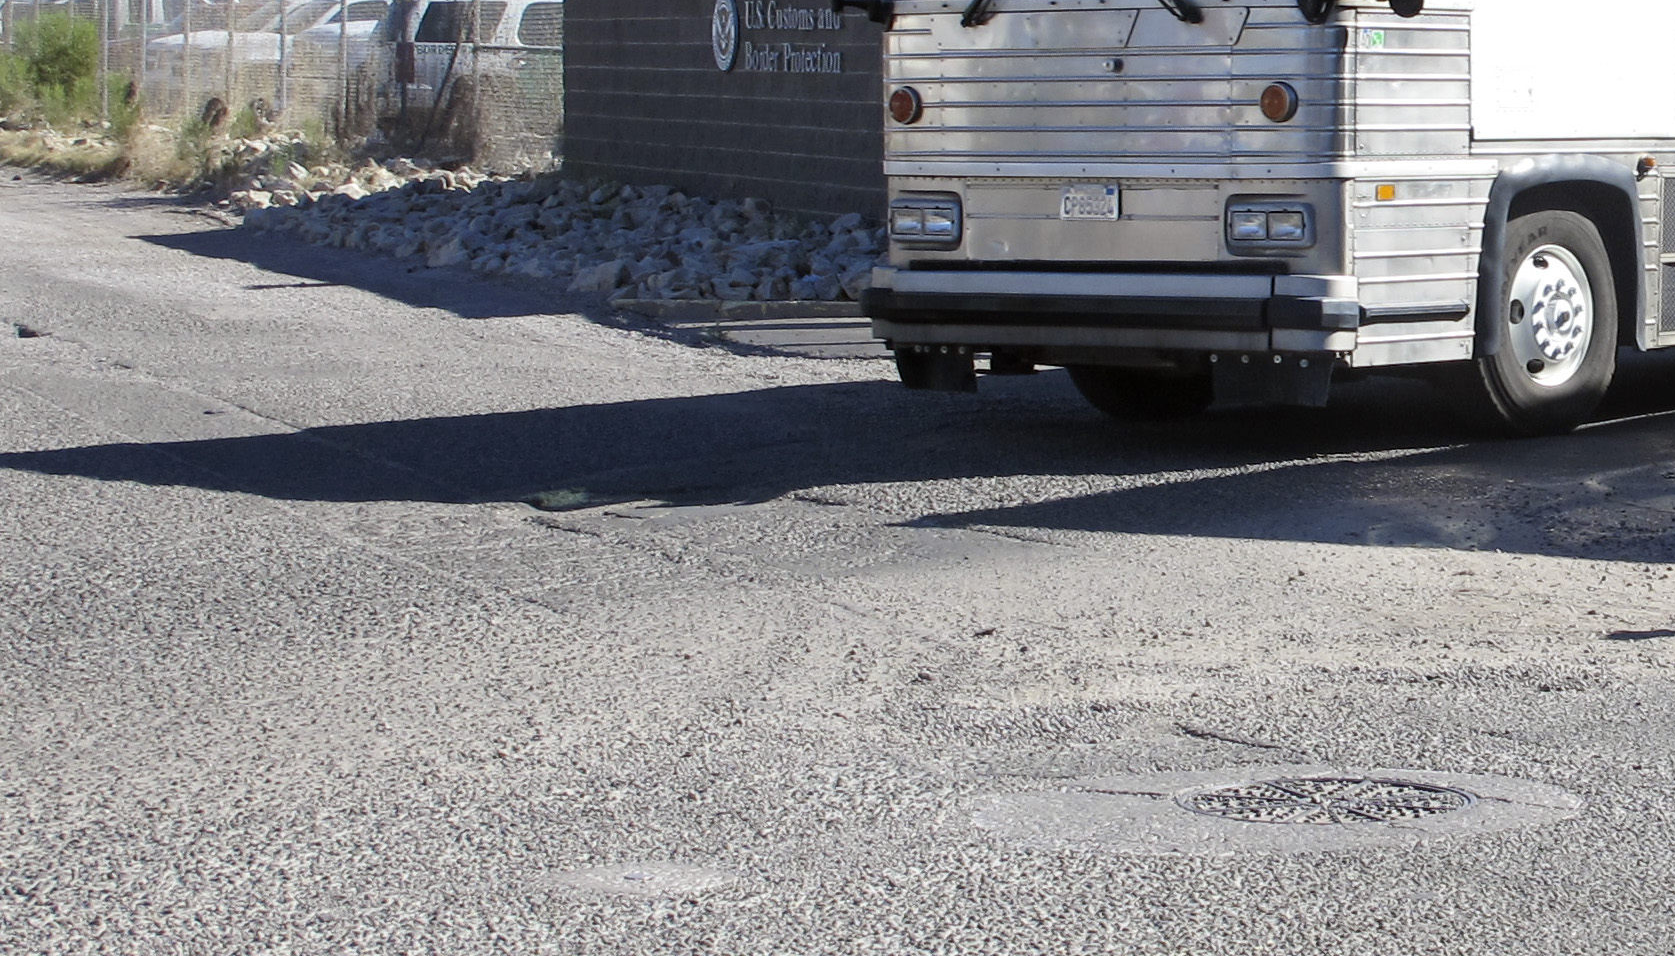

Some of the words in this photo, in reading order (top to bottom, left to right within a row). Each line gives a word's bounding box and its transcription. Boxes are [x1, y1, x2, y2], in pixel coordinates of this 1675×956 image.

[768, 0, 814, 30] Customs
[818, 8, 840, 29] and
[744, 41, 779, 72] Border
[782, 43, 840, 73] Protection
